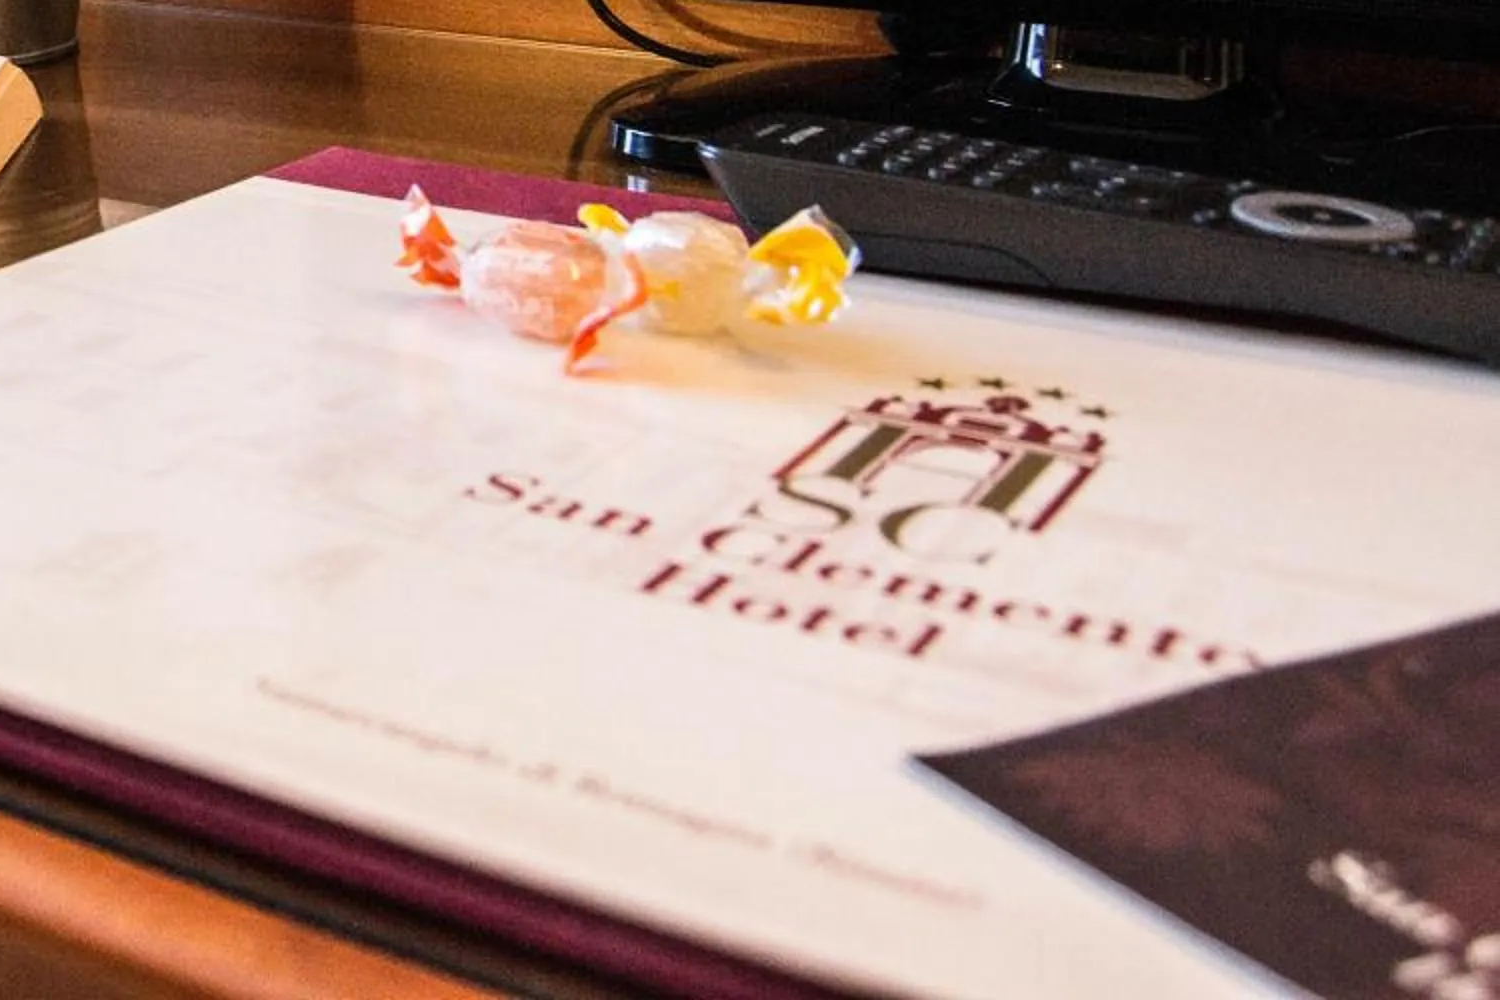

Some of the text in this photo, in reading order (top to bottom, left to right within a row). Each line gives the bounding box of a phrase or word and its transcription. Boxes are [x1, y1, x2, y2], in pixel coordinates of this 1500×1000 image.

[463, 472, 1262, 672] San Clemente
[637, 560, 943, 657] Hotel
